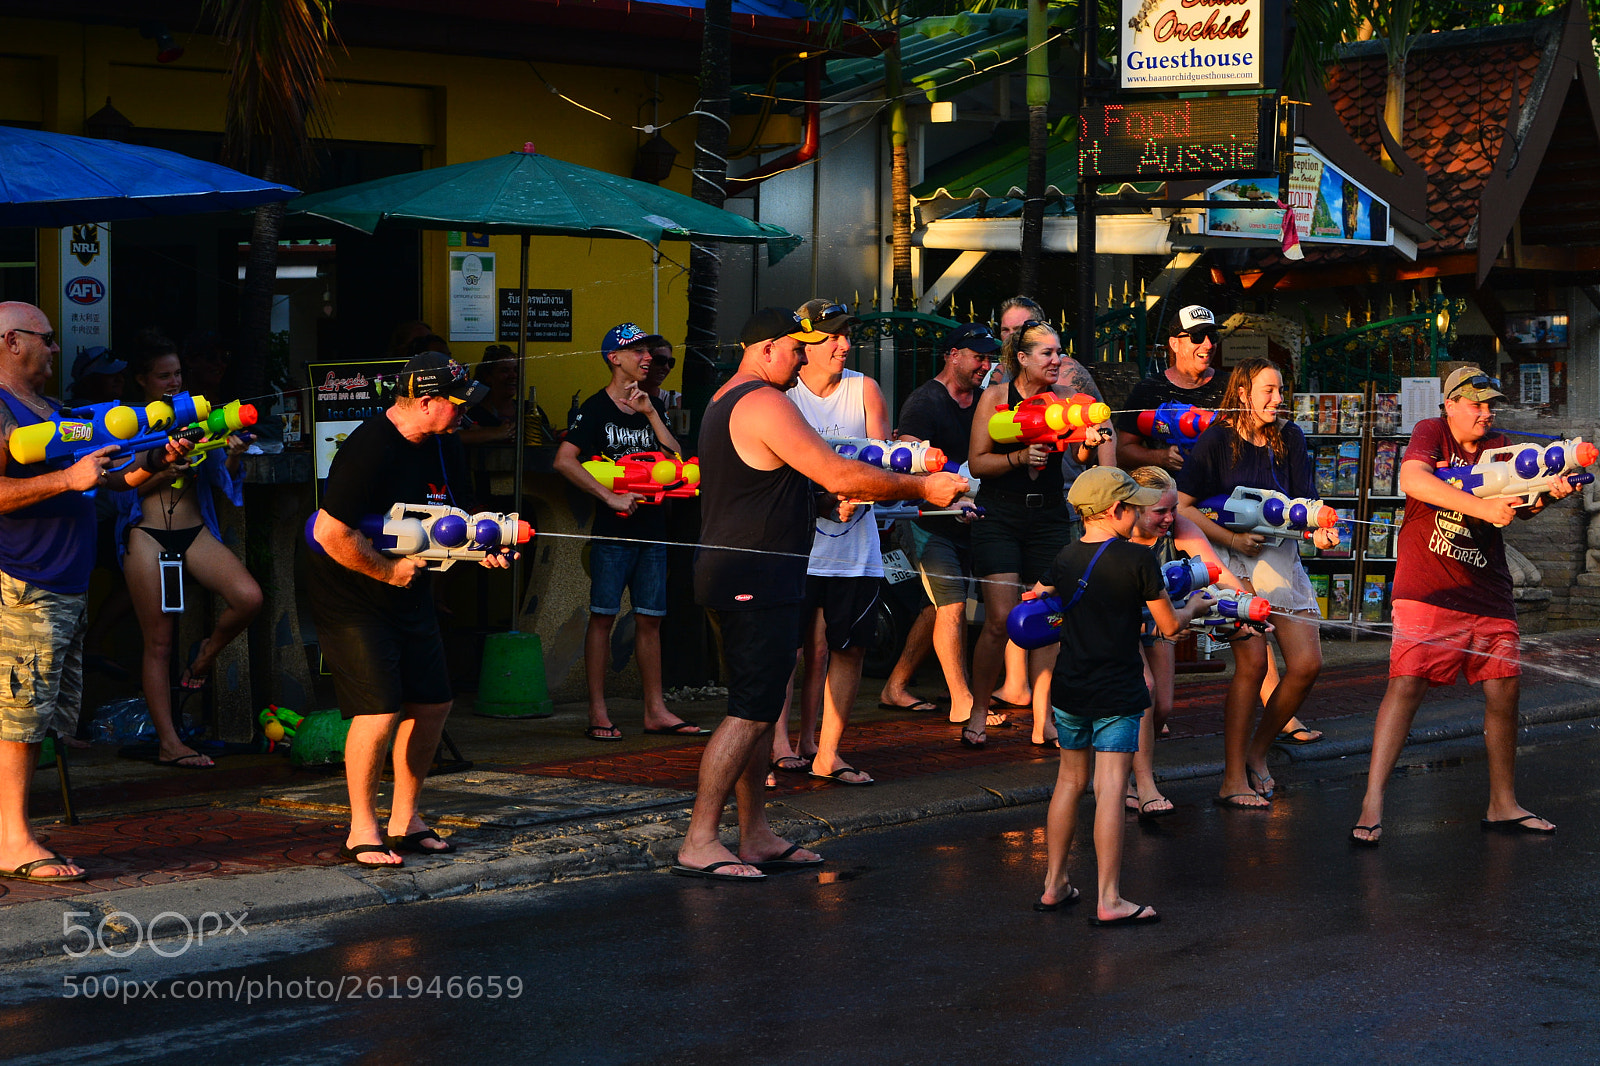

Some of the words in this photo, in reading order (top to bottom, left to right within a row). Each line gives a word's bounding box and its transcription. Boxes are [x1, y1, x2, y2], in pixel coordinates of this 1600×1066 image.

[1153, 8, 1251, 43] Orchid
[1126, 47, 1253, 71] Guesthouse
[1127, 70, 1253, 83] www.baanorchidguesthouse.com
[1104, 101, 1191, 139] Food
[1136, 134, 1255, 175] Aussie
[1293, 159, 1319, 173] ception
[1289, 191, 1313, 210] TOUR
[72, 242, 98, 253] NRL
[69, 282, 103, 298] AFL
[318, 371, 369, 392] Legends
[327, 408, 345, 419] Ice
[347, 406, 373, 418] Cold
[72, 425, 92, 439] 1500
